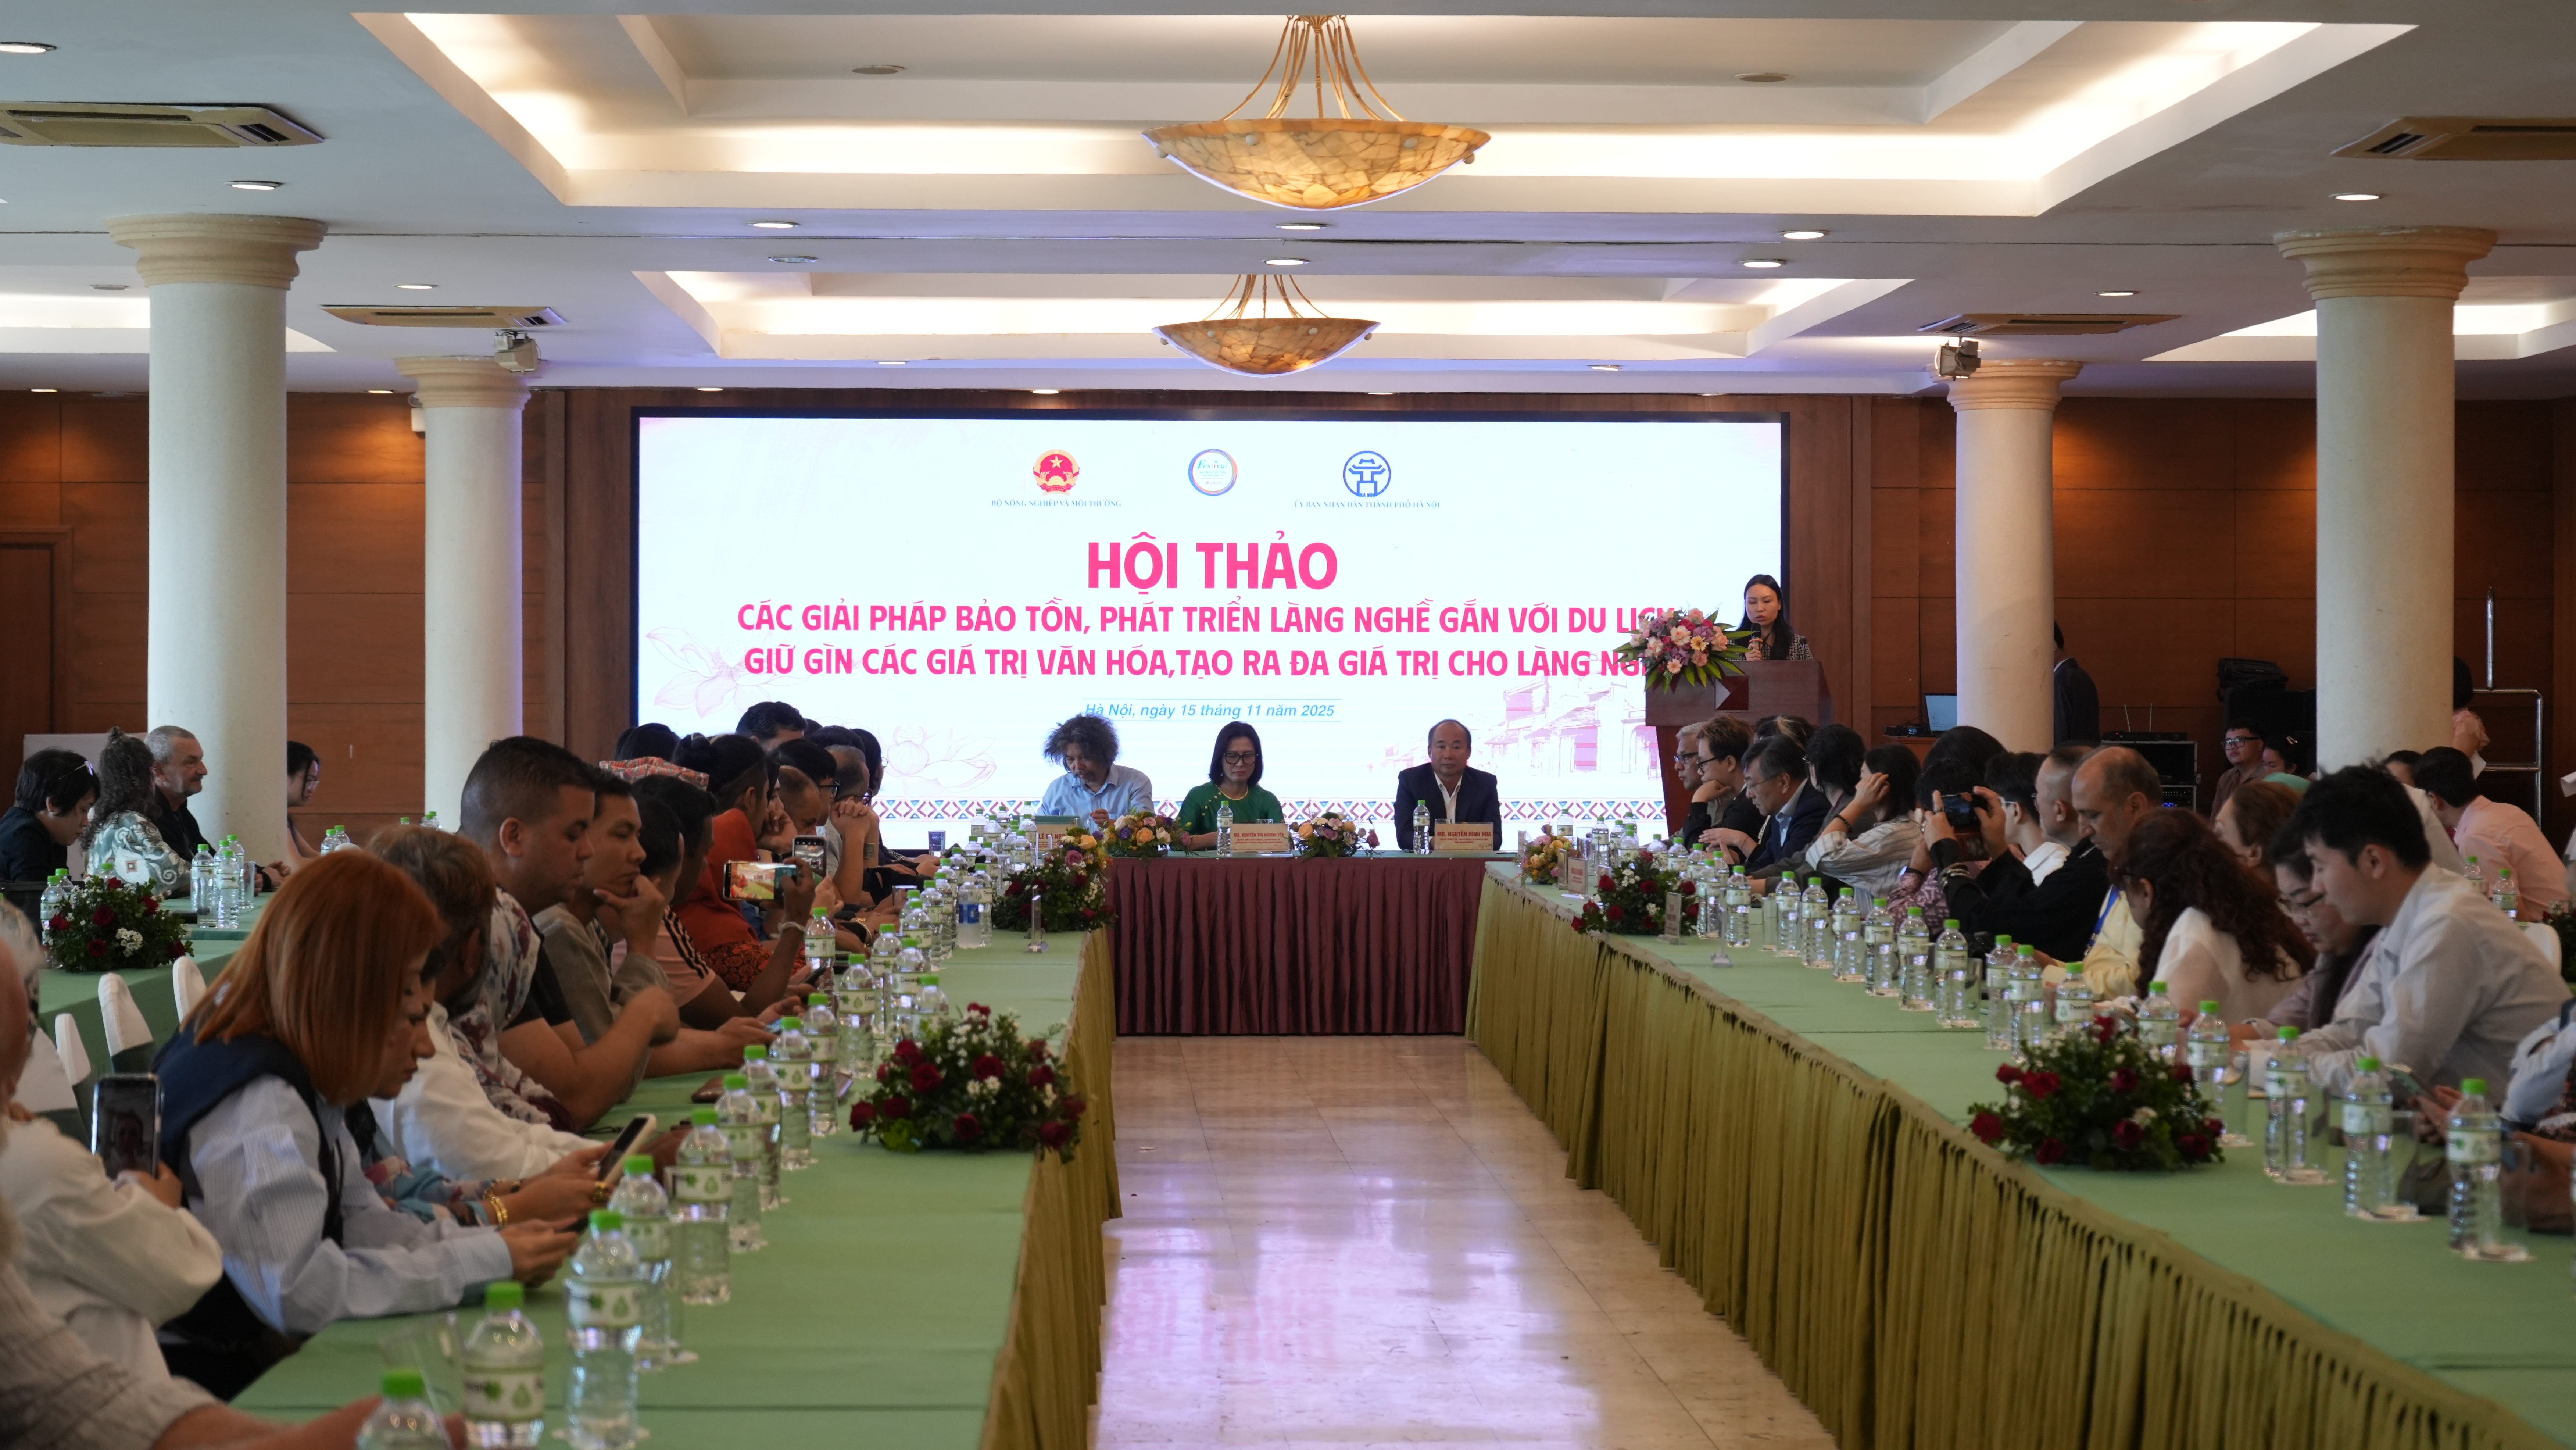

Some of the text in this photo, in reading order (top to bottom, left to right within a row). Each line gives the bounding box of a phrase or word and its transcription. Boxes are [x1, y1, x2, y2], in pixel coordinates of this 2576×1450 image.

[991, 499, 1003, 507] BỘ
[1004, 499, 1027, 507] NÔNG
[1028, 499, 1059, 508] NGHIỆP
[1060, 499, 1069, 507] VÀ
[1088, 499, 1121, 507] TRƯỜNG
[1394, 499, 1411, 508] PHỐ
[1413, 500, 1424, 508] HÀ
[1426, 500, 1440, 509] NỘI
[1088, 530, 1338, 595] HỘI THẢO
[738, 599, 793, 631] CÁC
[802, 598, 859, 631] GIẢI
[870, 601, 947, 631] PHÁP
[956, 599, 1016, 632] BẢO
[1026, 598, 1090, 635] TỒN,
[1101, 602, 1174, 632] PHÁT
[1183, 596, 1260, 632] TRIỂN
[1271, 602, 1344, 633] LÀNG
[1355, 597, 1434, 633] NGHỀ
[1439, 599, 1499, 633] GẮN
[1509, 603, 1558, 633] VỚI
[1569, 607, 1606, 633] DU
[744, 644, 795, 674] GIỮ
[804, 644, 853, 675] GÌN
[862, 644, 917, 675] CÁC
[927, 644, 976, 675] GIÁ
[985, 649, 1027, 679] TRỊ
[1037, 646, 1096, 675] VĂN
[1244, 650, 1281, 676] RA
[1289, 650, 1330, 676] ĐA
[1339, 645, 1388, 676] GIÁ
[1396, 650, 1438, 679] TRỊ
[1448, 650, 1508, 677] CHO
[1518, 646, 1591, 677] LÀNG
[1600, 651, 1646, 677] NG
[1085, 703, 1335, 719] Hà Nội, ngày 15 tháng 11 năm 2025
